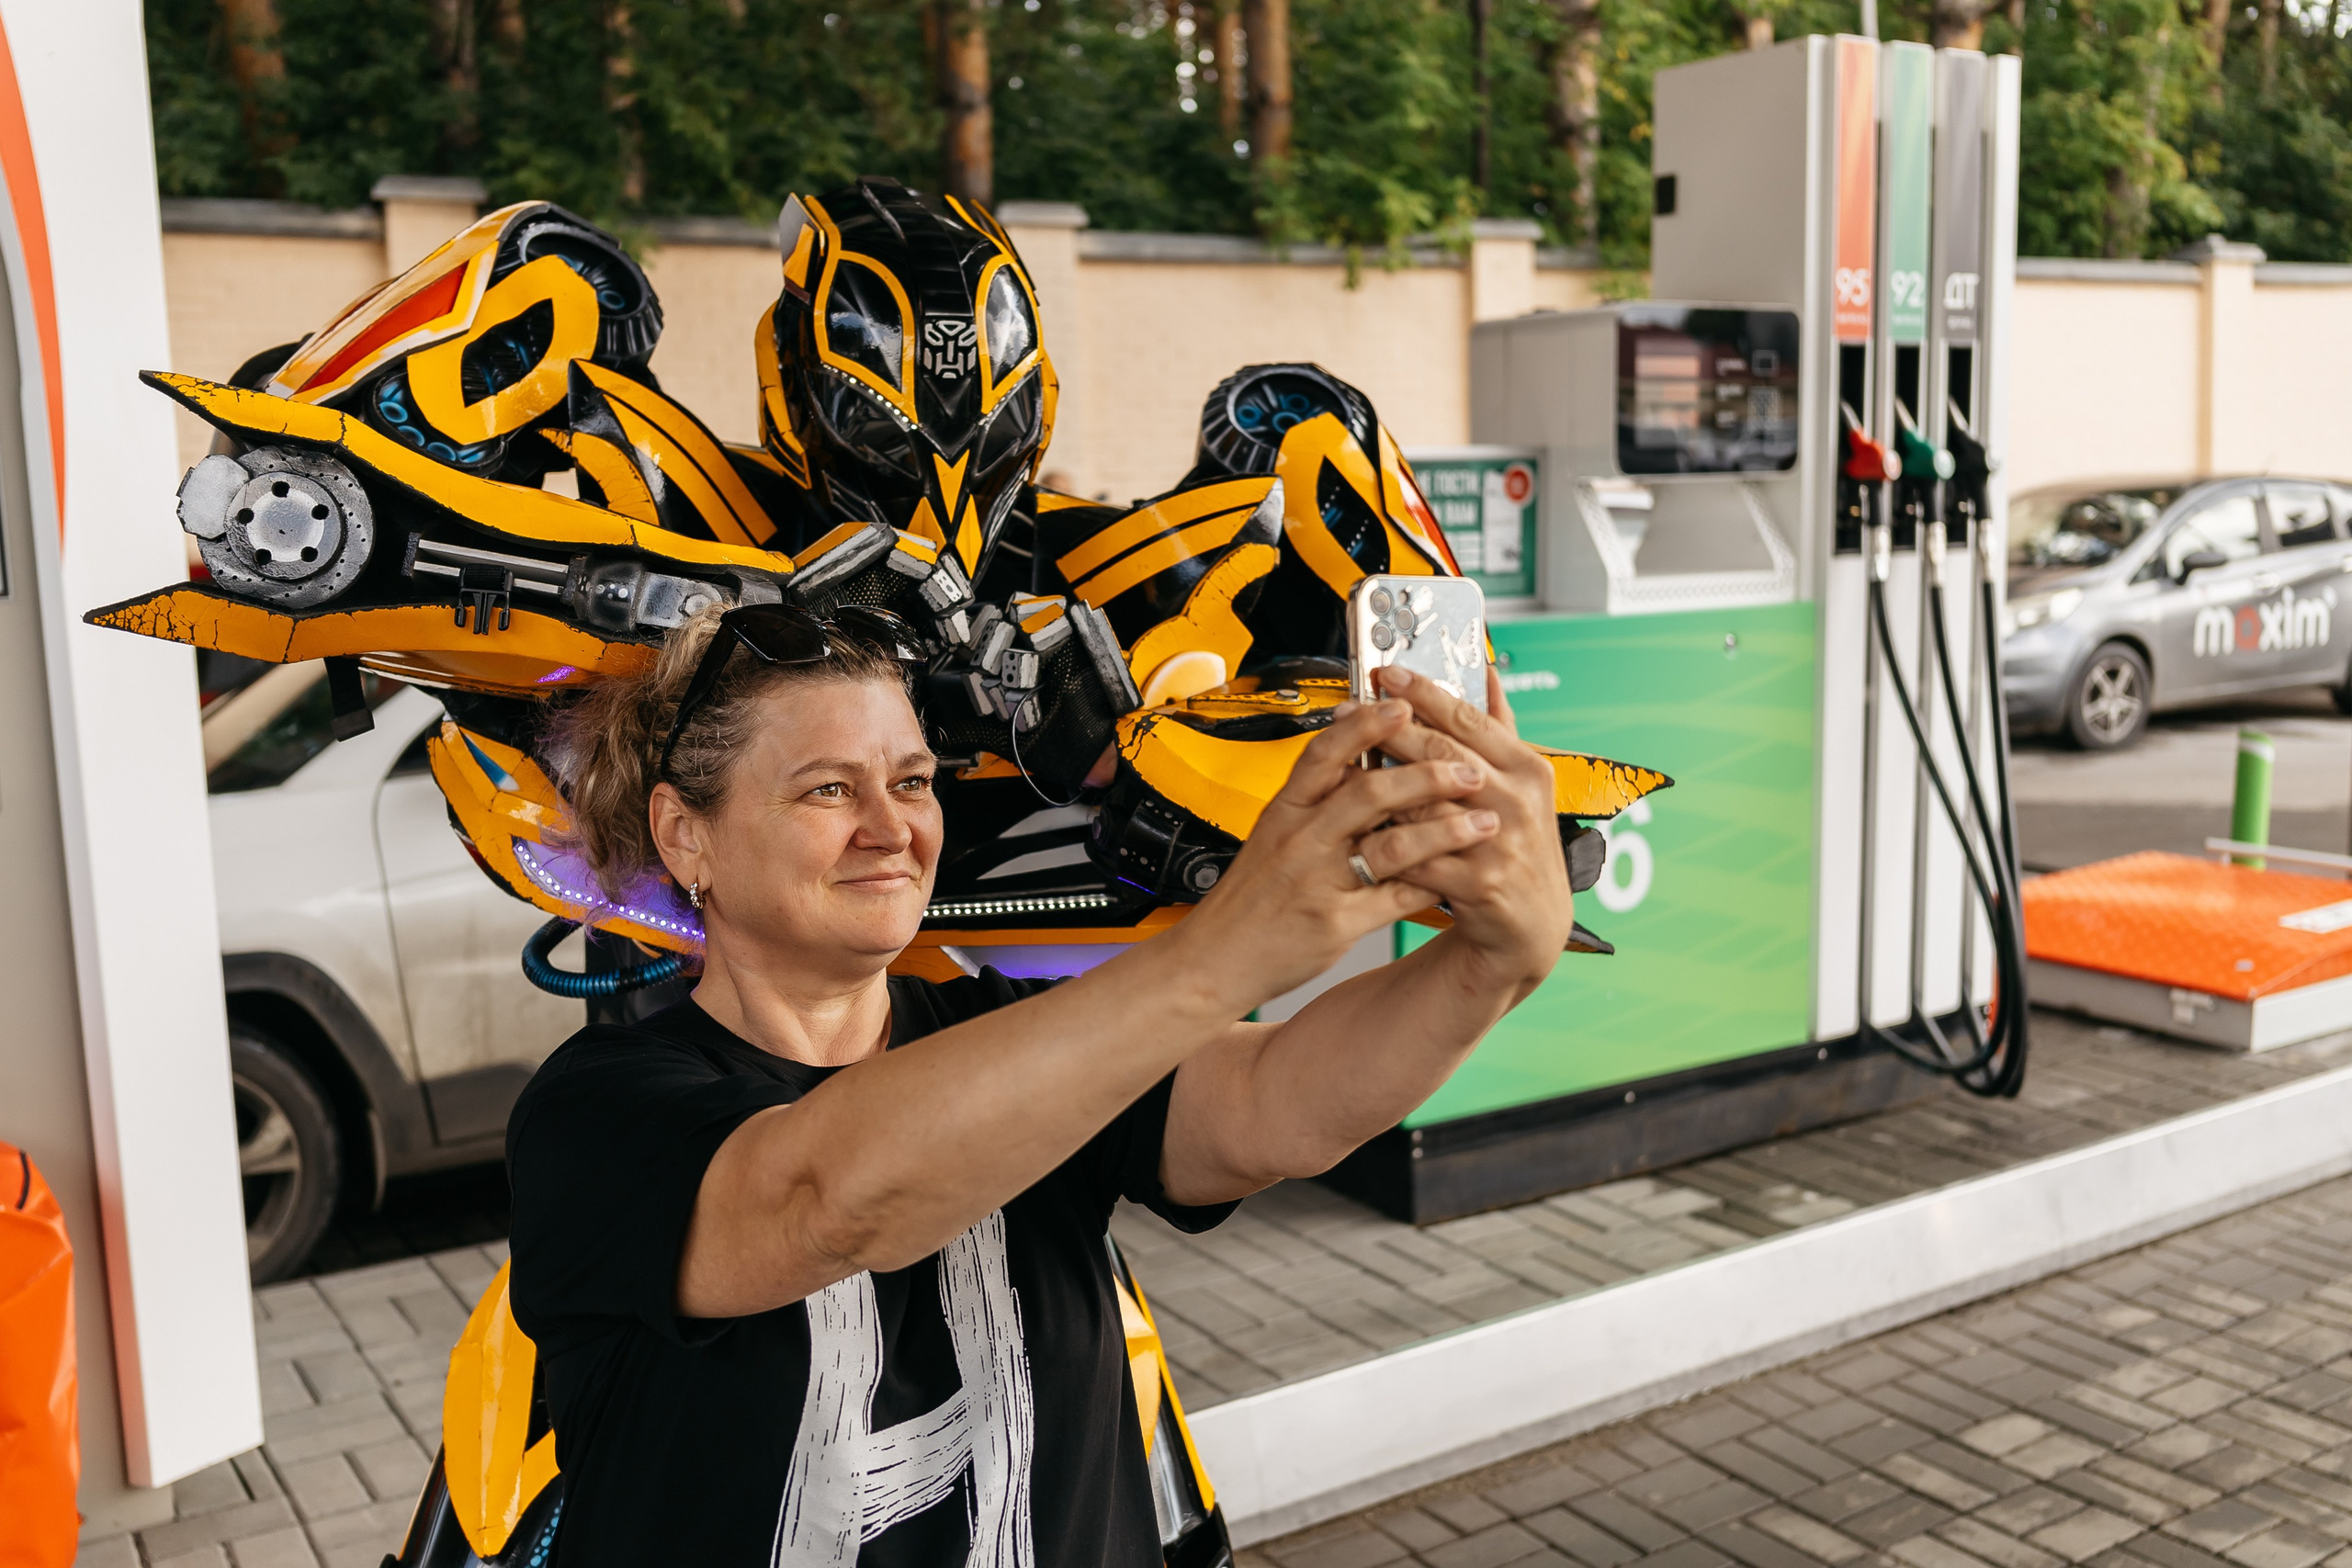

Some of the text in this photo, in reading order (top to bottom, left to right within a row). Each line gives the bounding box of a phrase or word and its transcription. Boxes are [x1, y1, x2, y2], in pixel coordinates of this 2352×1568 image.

[1836, 267, 1871, 306] 95
[1891, 270, 1925, 307] 92
[1944, 272, 1980, 310] ДТ
[1594, 797, 1654, 913] 6
